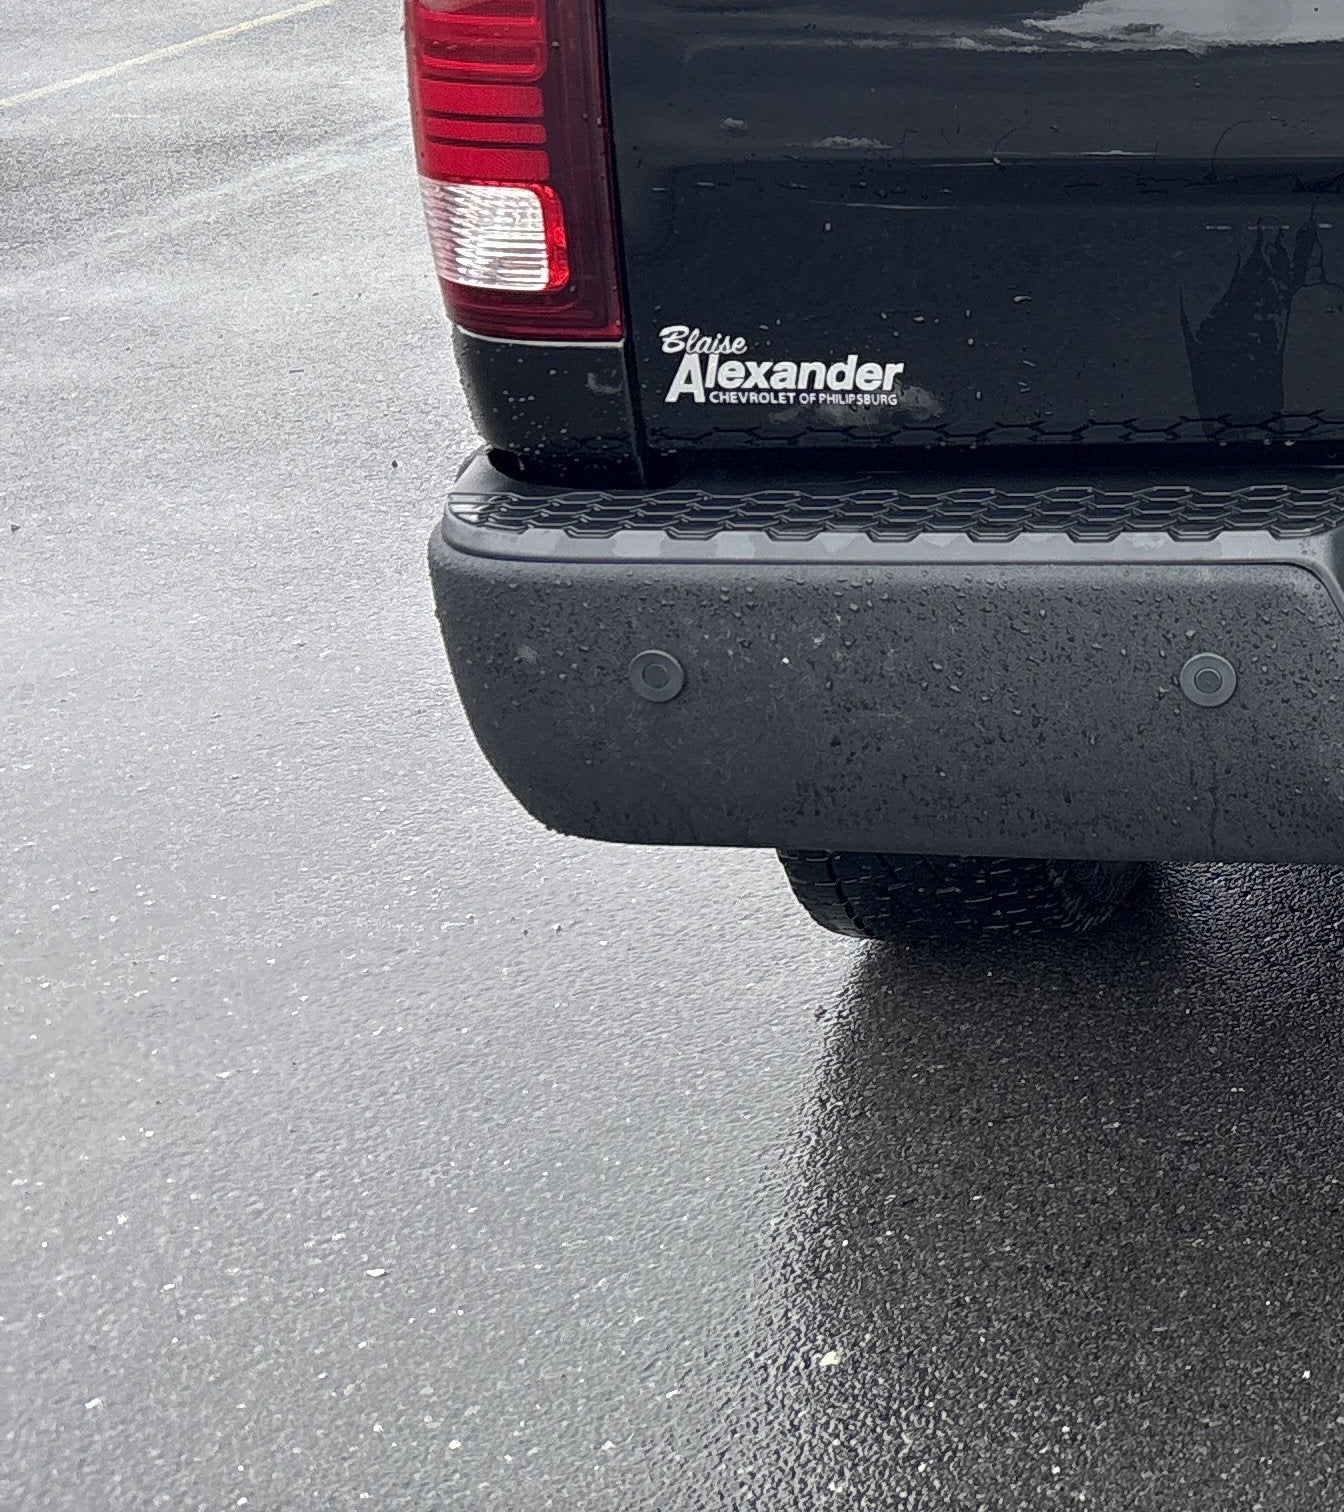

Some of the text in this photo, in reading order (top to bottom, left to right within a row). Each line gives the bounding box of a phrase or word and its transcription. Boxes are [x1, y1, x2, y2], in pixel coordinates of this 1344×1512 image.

[659, 325, 748, 355] Blaise
[664, 353, 905, 404] Alexander
[709, 390, 898, 407] CHEVROLET OF PHILIPSBURG
